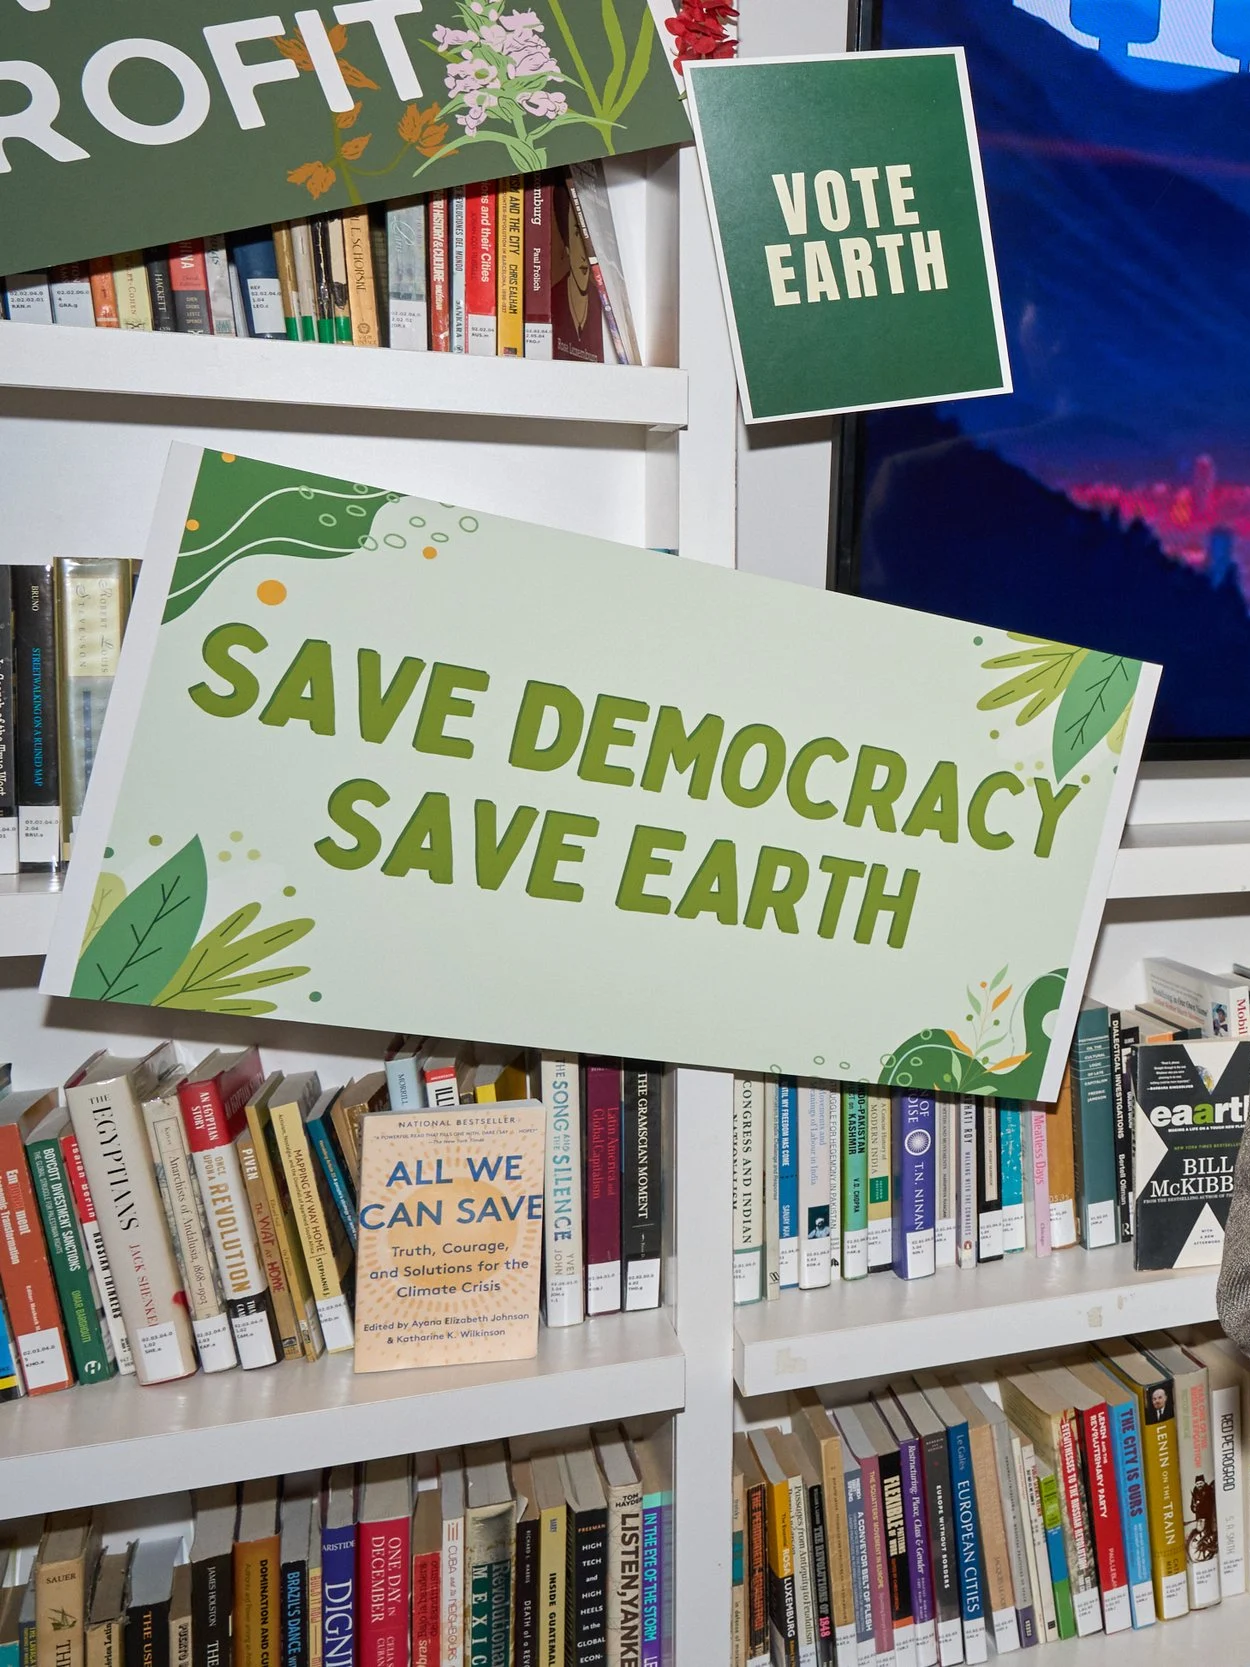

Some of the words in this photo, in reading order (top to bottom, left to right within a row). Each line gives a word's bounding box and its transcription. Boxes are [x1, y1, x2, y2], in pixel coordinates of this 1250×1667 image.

[509, 196, 520, 214] AND
[772, 164, 920, 236] VOTE
[481, 206, 491, 225] and
[509, 217, 520, 233] THE
[481, 227, 491, 251] their
[509, 235, 520, 255] CITY
[481, 253, 491, 283] Cities
[509, 264, 518, 285] CHRIS
[765, 230, 948, 307] EARTH
[509, 287, 518, 315] EALHAM
[32, 585, 40, 612] BRUNO
[33, 647, 41, 715] STREETWALKING
[34, 738, 43, 767] RUINED
[188, 622, 490, 760] SAVE
[509, 679, 1080, 859] DEMOCRACY
[34, 769, 43, 787] MAP
[314, 777, 600, 904] SAVE
[615, 824, 921, 949] EARTH
[1111, 1019, 1121, 1073] DIALECTICAL
[555, 1060, 566, 1078] THE
[200, 1091, 209, 1105] AN
[638, 1072, 649, 1097] THE
[89, 1094, 110, 1106] THE
[552, 1079, 570, 1133] SONG
[1114, 1073, 1124, 1139] INVESTIGATIONS
[191, 1106, 204, 1129] STORY
[201, 1107, 219, 1141] EGYPTIAN
[398, 1119, 452, 1129] NATIONAL
[456, 1117, 516, 1126] BESTSELLER
[742, 1080, 752, 1153] CONGRESS
[553, 1135, 561, 1151] THE
[638, 1100, 649, 1169] GRAMSCIAN
[1033, 1114, 1046, 1159] Meatless
[43, 1148, 60, 1181] BOYCOTT
[91, 1106, 140, 1232] EGYPTIANS
[241, 1148, 260, 1181] PIVEN
[294, 1149, 310, 1191] MAPPING
[386, 1159, 453, 1188] ALL
[466, 1155, 523, 1183] WE
[742, 1158, 752, 1187] AND
[914, 1161, 924, 1186] T.N.
[1036, 1160, 1048, 1186] Days
[1182, 1156, 1235, 1176] BILL
[168, 1156, 186, 1203] Anarchists
[51, 1183, 71, 1228] DIVESTMENT
[180, 1203, 187, 1214] of
[304, 1192, 312, 1204] MY
[552, 1154, 572, 1242] SILENCE
[638, 1171, 649, 1219] MOMENT
[914, 1188, 925, 1231] NINAN
[306, 1205, 317, 1222] WAY
[359, 1199, 442, 1231] CAN
[456, 1194, 543, 1225] SAVE
[742, 1192, 752, 1244] INDIAN
[62, 1228, 81, 1272] SANCTIONS
[183, 1213, 197, 1264] Andalusia,
[208, 1182, 251, 1294] REVOLUTION
[311, 1223, 324, 1253] HOME
[392, 1244, 436, 1259] Truth,
[442, 1240, 509, 1258] Courage,
[370, 1266, 398, 1280] and
[404, 1262, 472, 1277] Solutions
[477, 1260, 499, 1272] for
[503, 1258, 529, 1271] the
[396, 1284, 456, 1298] Climate
[461, 1281, 501, 1294] Crisis
[364, 1322, 394, 1332] Edited
[397, 1320, 409, 1332] by
[411, 1317, 442, 1329] Ayana
[444, 1314, 488, 1325] Elizabeth
[490, 1311, 530, 1322] Johnson
[386, 1336, 394, 1344] &
[396, 1332, 445, 1343] Katharine
[447, 1331, 457, 1339] K.
[460, 1328, 506, 1338] Wilkinson
[1097, 1411, 1107, 1439] LENIN
[1120, 1408, 1134, 1434] THE
[1221, 1413, 1233, 1434] RED
[1123, 1436, 1138, 1465] CITY
[1156, 1425, 1170, 1468] LENIN
[1089, 1414, 1106, 1484] REVOLUTIONARY
[1099, 1487, 1108, 1518] PARTY
[1127, 1466, 1139, 1481] IS
[1162, 1471, 1168, 1484] ON
[1222, 1434, 1236, 1492] PETROGRAD
[793, 1485, 803, 1526] Passages
[936, 1485, 944, 1515] EUROPE
[1128, 1484, 1144, 1518] OURS
[644, 1513, 657, 1525] IN
[957, 1480, 975, 1562] EUROPEAN
[1163, 1502, 1176, 1545] TRAIN
[582, 1542, 602, 1551] HIGH
[644, 1526, 657, 1547] THE
[798, 1527, 806, 1549] from
[938, 1517, 947, 1552] WITHOUT
[387, 1537, 402, 1572] ONE
[582, 1558, 602, 1567] TECH
[644, 1548, 657, 1568] EYE
[783, 1548, 791, 1575] ROSA
[46, 1572, 77, 1585] SAUER
[371, 1535, 386, 1623] DECEMBER
[586, 1574, 598, 1583] and
[644, 1569, 657, 1582] OF
[800, 1549, 811, 1590] Antiquity
[942, 1554, 950, 1589] BORDERS
[259, 1559, 269, 1625] DOMINATION
[287, 1571, 300, 1618] BRAZIL'S
[387, 1572, 402, 1603] DAY
[549, 1573, 557, 1607] INSIDE
[581, 1590, 602, 1599] HIGH
[644, 1583, 657, 1604] THE
[965, 1566, 980, 1613] CITIES
[388, 1606, 396, 1617] IN
[580, 1605, 604, 1615] HEELS
[784, 1577, 796, 1638] LUXEMBURG
[287, 1618, 301, 1653] DANCE
[583, 1623, 589, 1631] in
[644, 1605, 657, 1642] STORM
[804, 1600, 814, 1645] Feudalism
[819, 1616, 831, 1638] 1848
[260, 1626, 269, 1649] AND
[577, 1637, 606, 1648] GLOBAL
[580, 1654, 603, 1664] ECON-
